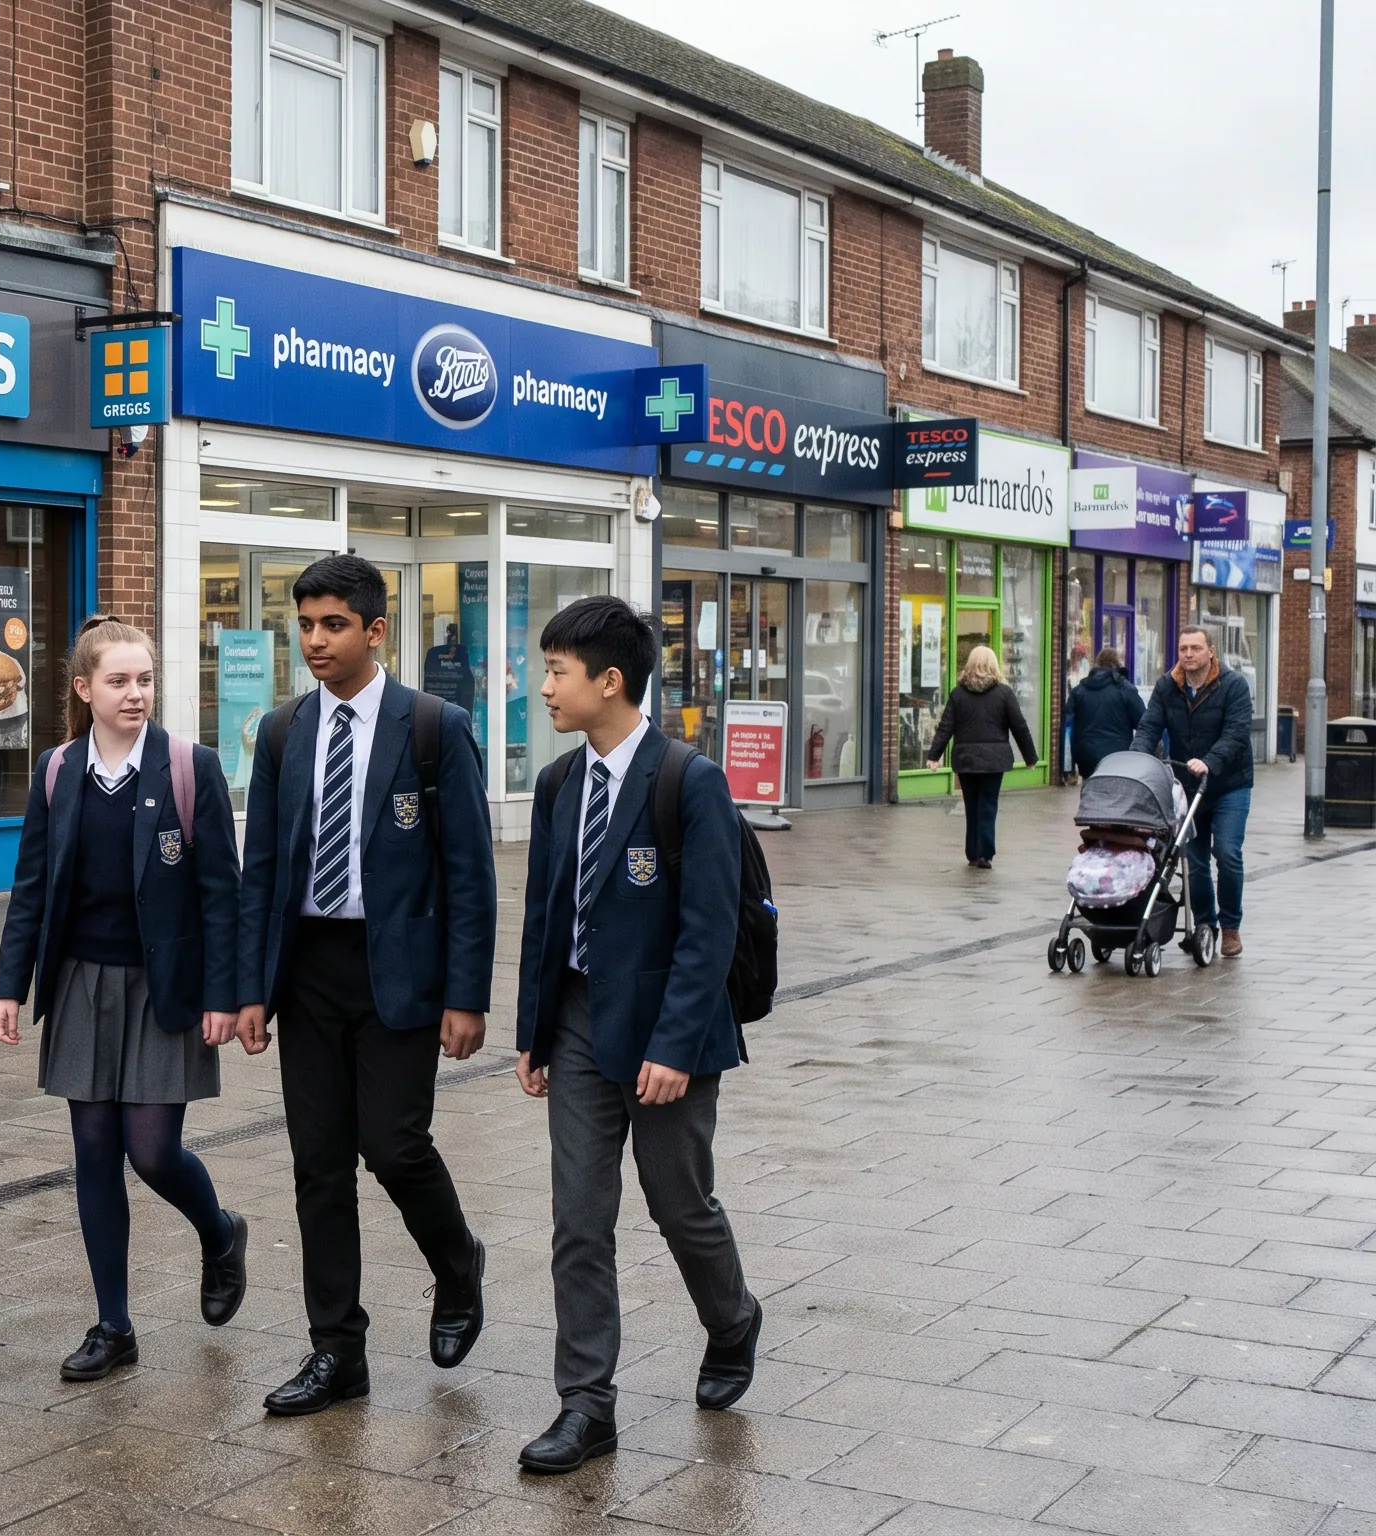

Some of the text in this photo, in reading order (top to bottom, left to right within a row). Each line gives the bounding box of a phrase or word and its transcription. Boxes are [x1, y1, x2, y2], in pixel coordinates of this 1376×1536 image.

[274, 327, 395, 387] pharmacy
[428, 345, 490, 402] Boots
[104, 402, 151, 417] GREGGS
[513, 370, 608, 421] pharmacy
[709, 397, 880, 476] ESCO express
[906, 428, 969, 443] TESCO
[906, 450, 967, 465] express
[1073, 500, 1129, 512] Barnardo's
